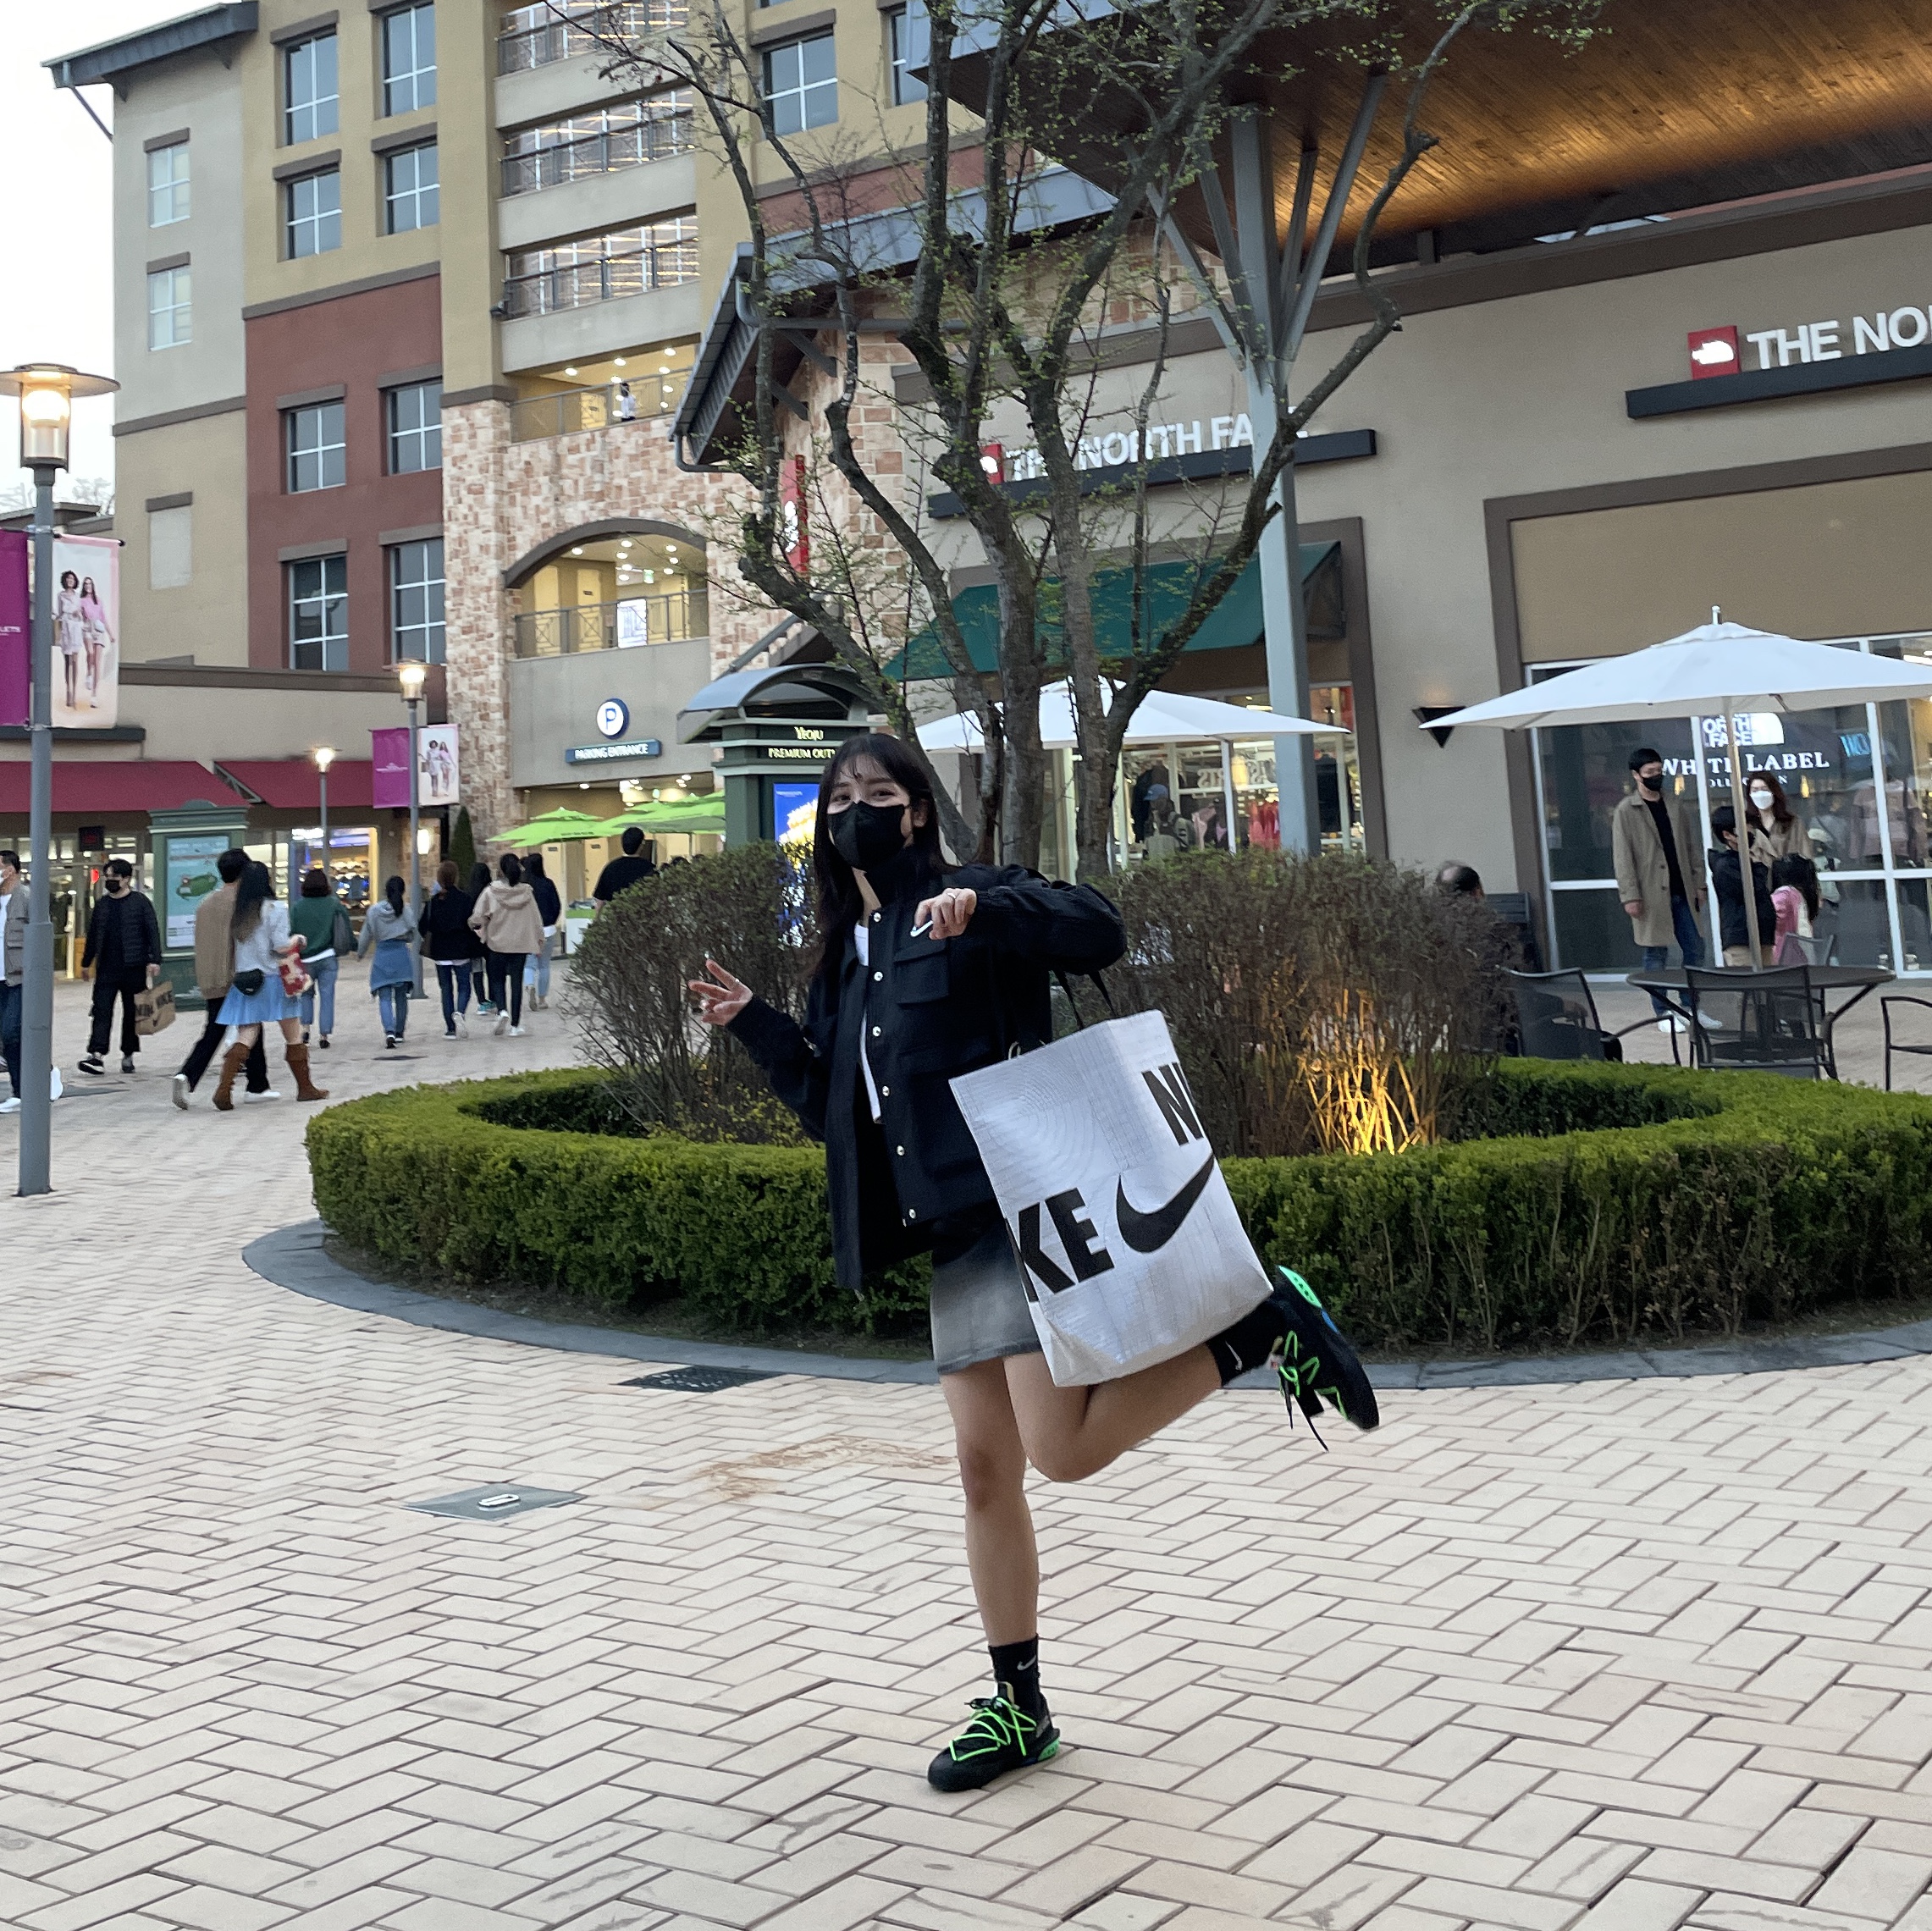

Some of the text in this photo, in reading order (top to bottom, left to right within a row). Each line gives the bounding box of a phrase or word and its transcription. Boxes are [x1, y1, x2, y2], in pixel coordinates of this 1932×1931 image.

[1746, 305, 1932, 370] THE NO
[1078, 420, 1202, 472] NORTH
[604, 708, 617, 730] P
[1703, 715, 1750, 734] ORTH
[812, 748, 836, 759] OUT
[1661, 751, 1830, 777] WHT LABEL
